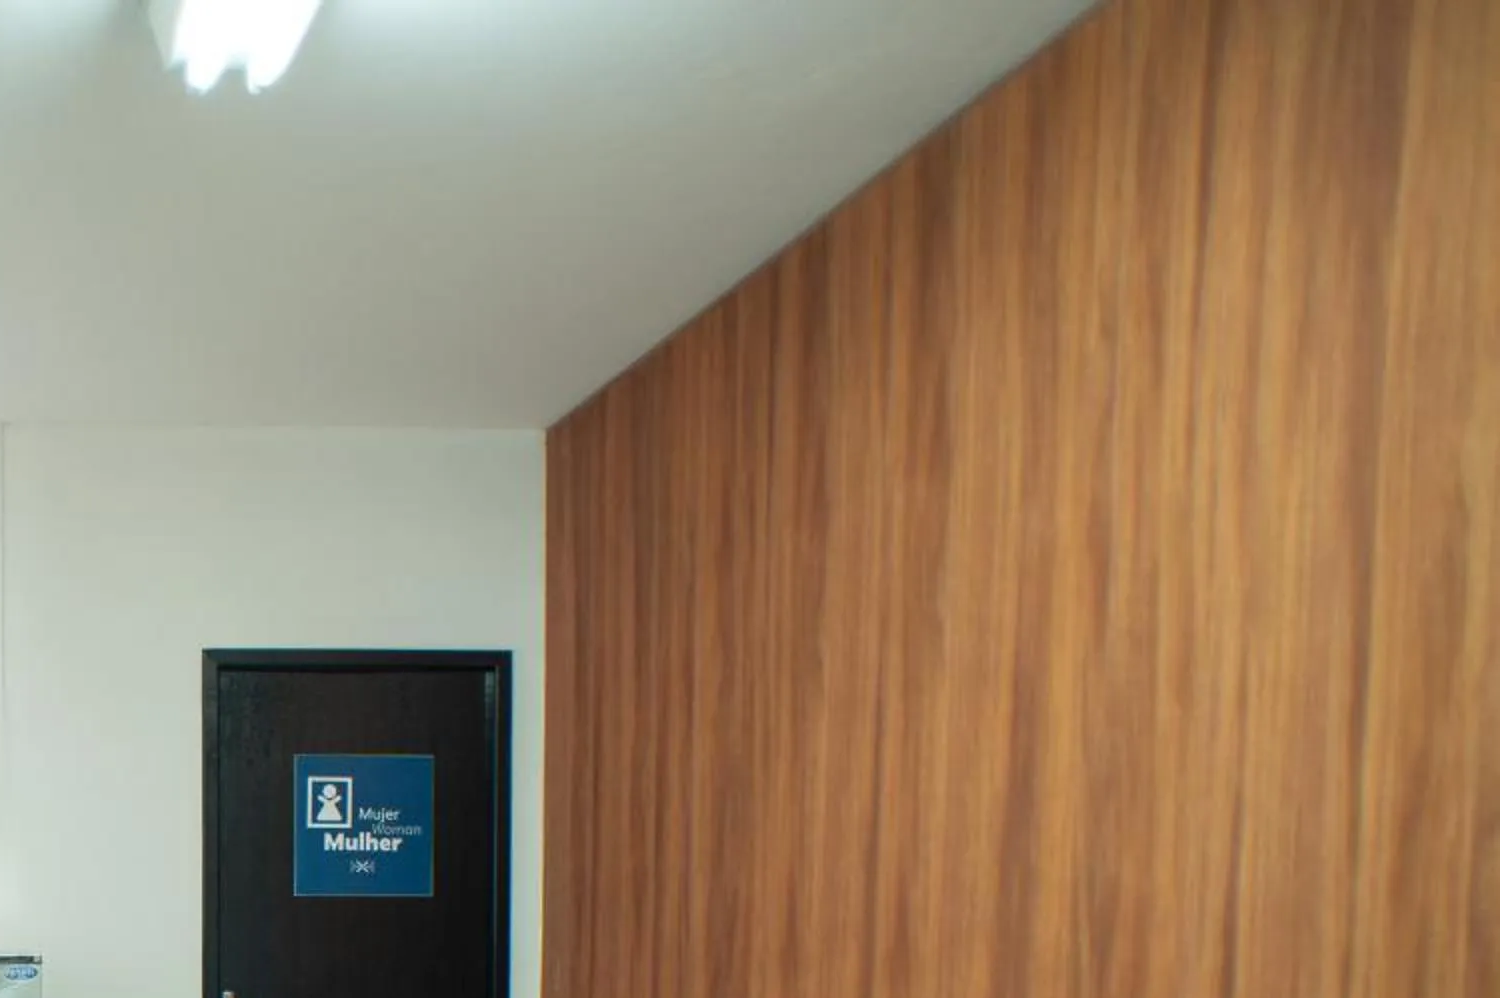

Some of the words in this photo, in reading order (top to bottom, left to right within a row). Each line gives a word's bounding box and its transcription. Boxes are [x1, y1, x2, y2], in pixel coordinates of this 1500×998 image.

[358, 807, 400, 822] Mujer
[372, 823, 421, 835] Woman
[323, 831, 403, 851] Mulher
